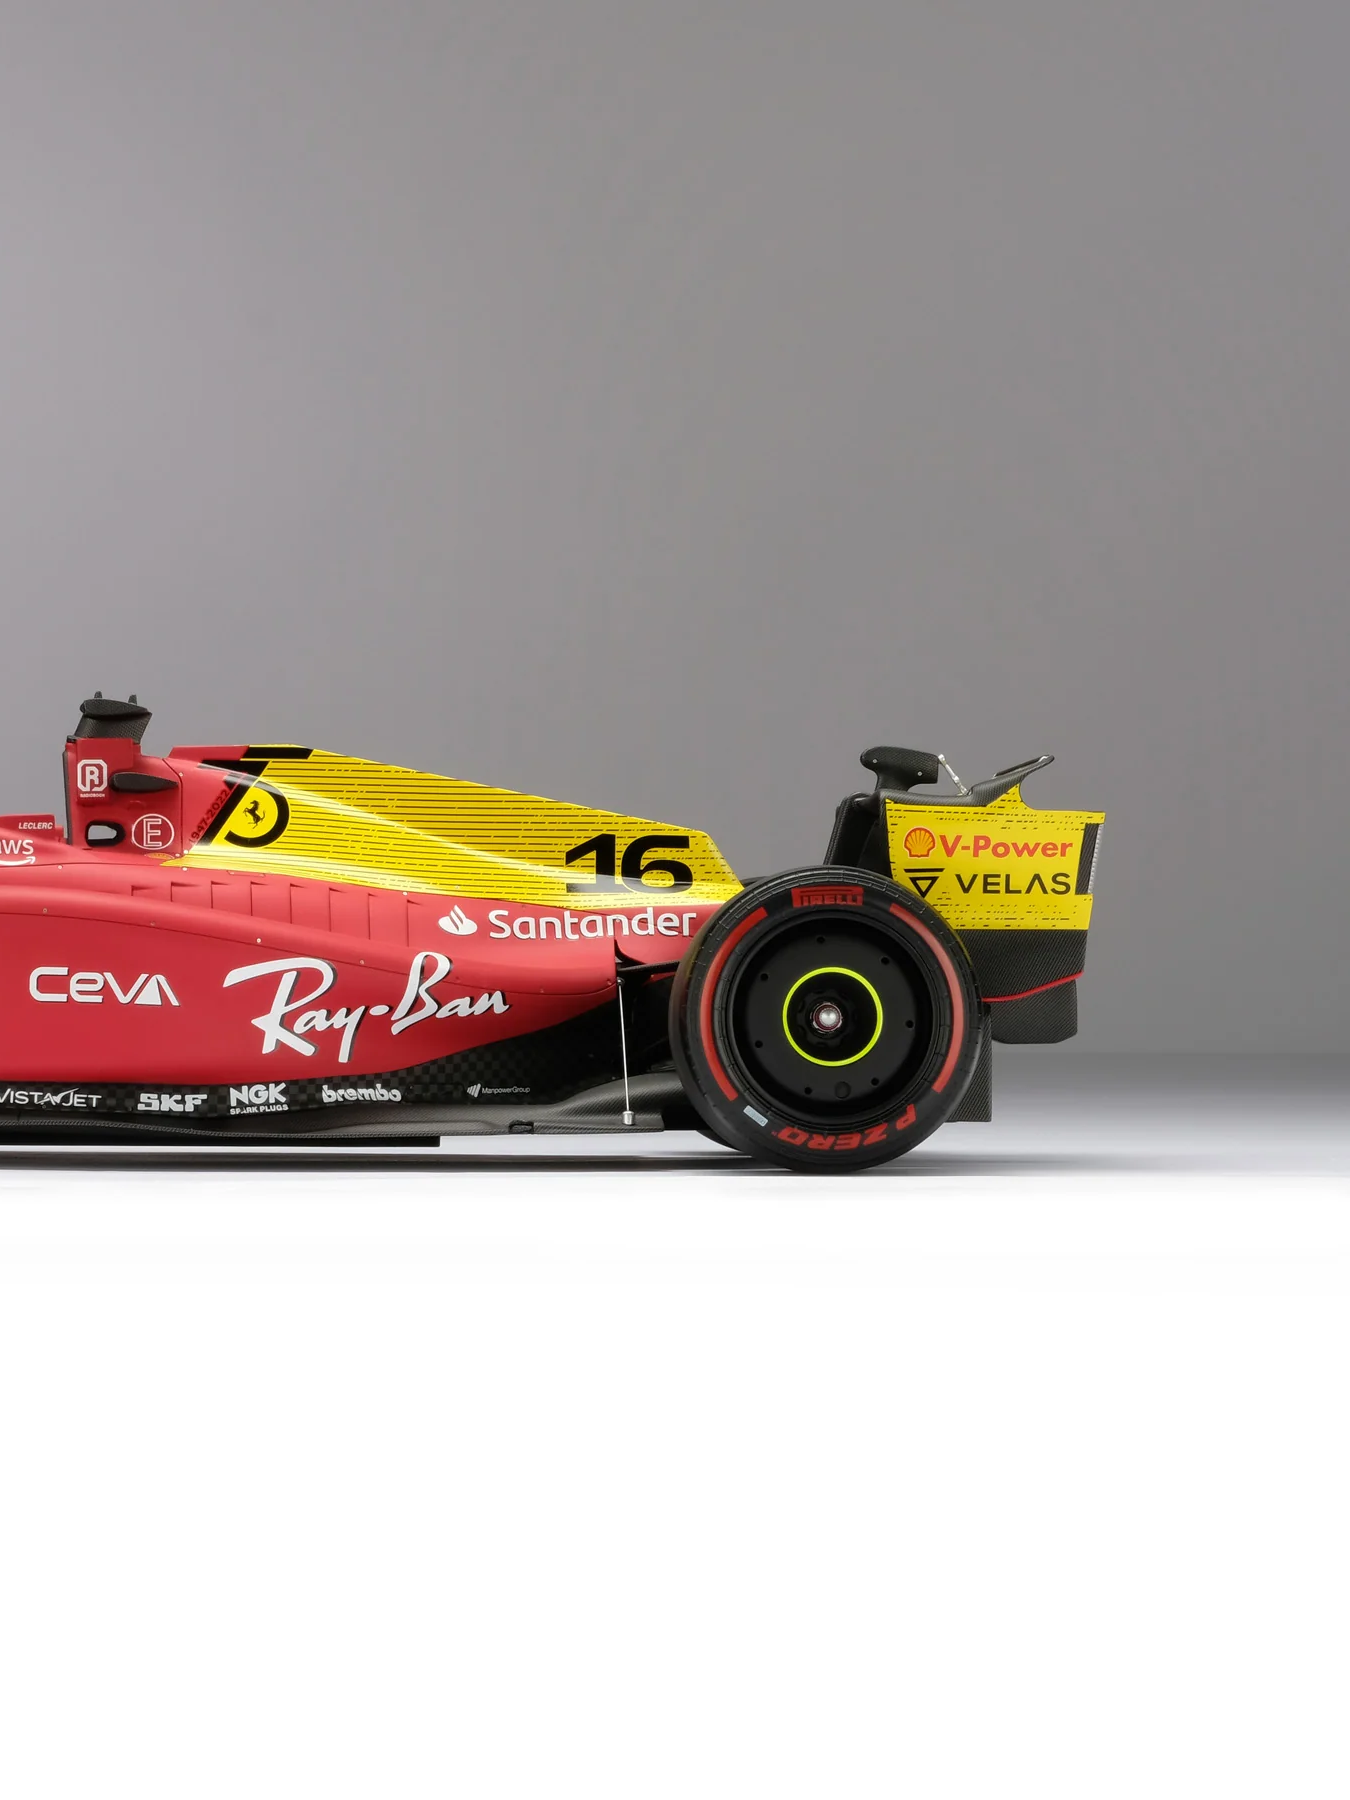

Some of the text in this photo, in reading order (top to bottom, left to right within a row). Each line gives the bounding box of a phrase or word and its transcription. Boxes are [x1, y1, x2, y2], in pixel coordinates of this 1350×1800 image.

[18, 822, 53, 830] LECLERC
[940, 834, 1073, 859] V-Power
[565, 833, 694, 893] 16
[955, 872, 1072, 895] VELAS
[791, 885, 864, 908] PIRELLI
[487, 907, 697, 940] Santander
[223, 951, 510, 1063] Ray-Ban
[229, 1082, 287, 1107] NGK
[322, 1083, 402, 1103] brembo
[481, 1085, 530, 1095] ManpowerGroup
[137, 1093, 208, 1112] SKF
[229, 1104, 289, 1116] SPARK PLUGS
[777, 1103, 916, 1151] P ZERO
